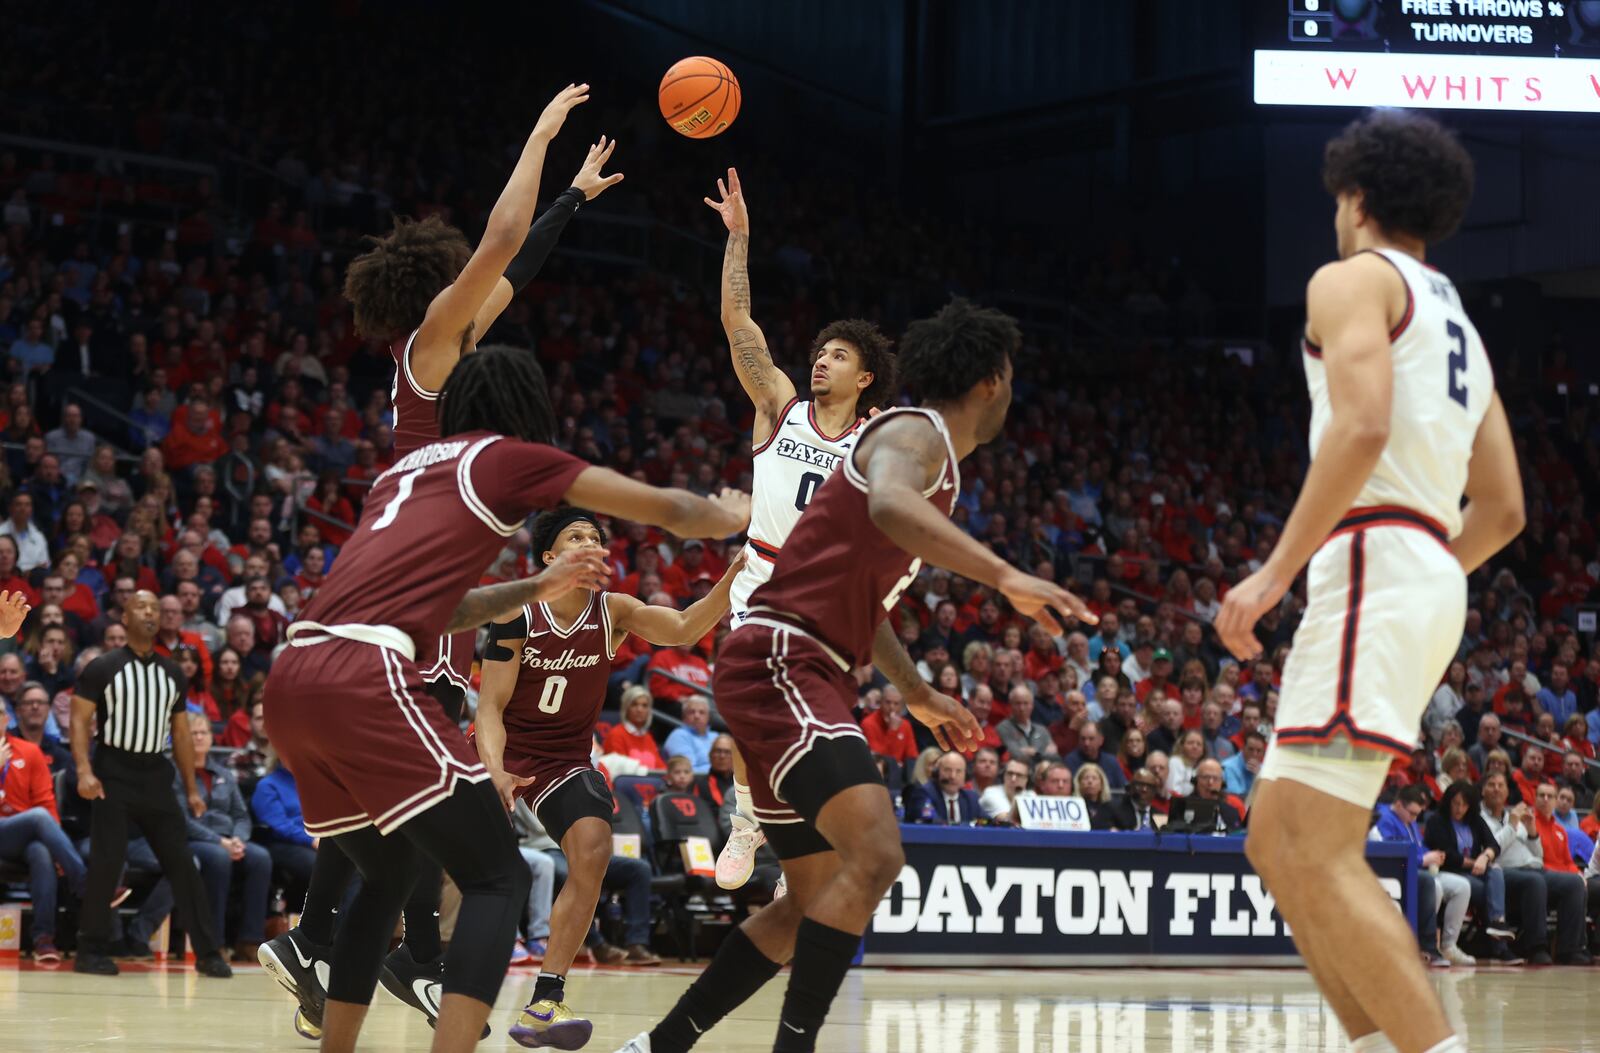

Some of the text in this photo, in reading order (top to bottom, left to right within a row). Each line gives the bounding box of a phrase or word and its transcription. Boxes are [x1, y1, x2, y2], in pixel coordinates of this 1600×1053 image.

[1401, 0, 1565, 18] FREE THROWS %
[1303, 20, 1319, 36] 0
[1411, 22, 1534, 44] TURNOVERS
[1324, 68, 1357, 91] W
[1446, 319, 1468, 409] 2
[777, 438, 844, 472] DAYTO
[371, 468, 425, 530] 1
[795, 472, 825, 512] 0
[521, 646, 600, 671] Fordham
[538, 675, 568, 714] 0
[1023, 799, 1082, 821] WHIO
[872, 864, 1153, 936] DAYTON
